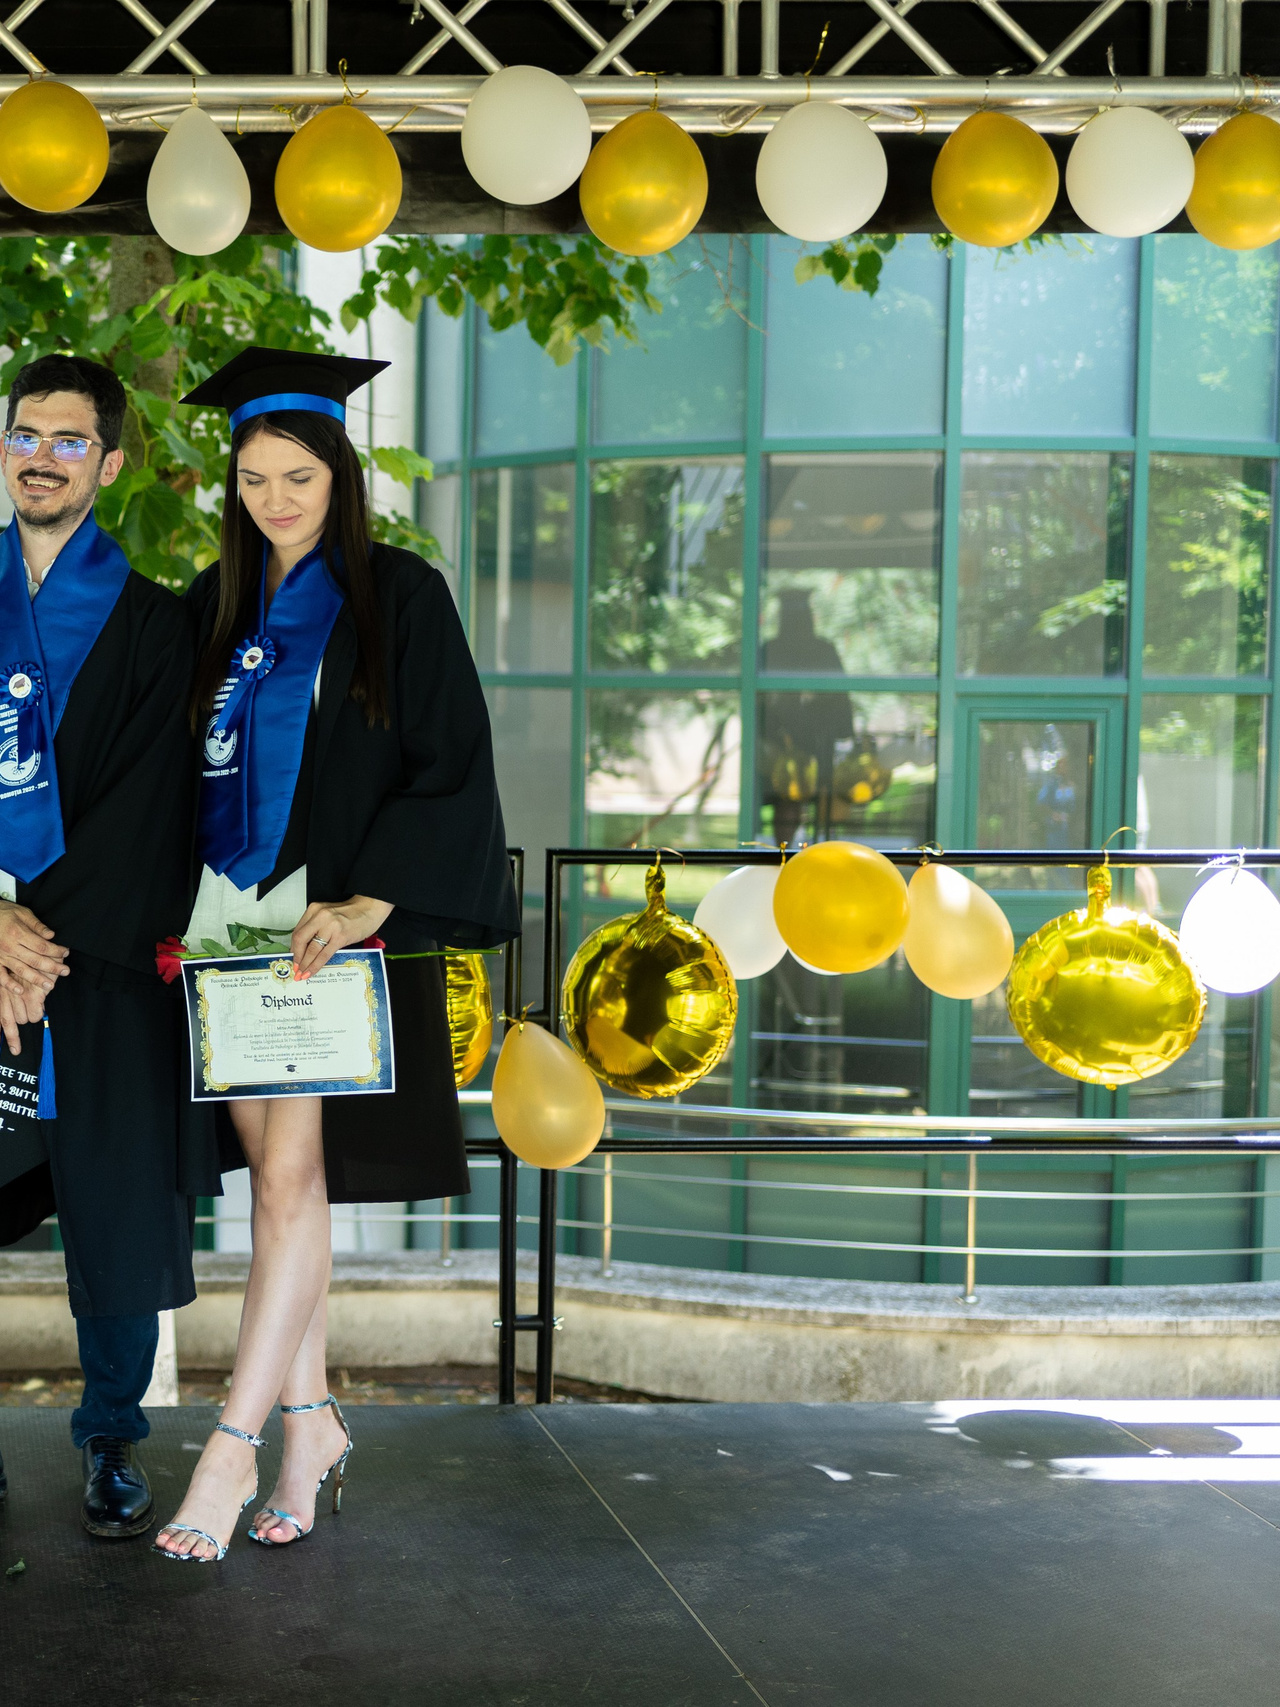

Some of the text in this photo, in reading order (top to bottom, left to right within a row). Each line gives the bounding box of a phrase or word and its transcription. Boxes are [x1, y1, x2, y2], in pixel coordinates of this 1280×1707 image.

[260, 993, 313, 1010] Diplomă
[17, 1071, 38, 1085] THE
[8, 1085, 32, 1100] BUT
